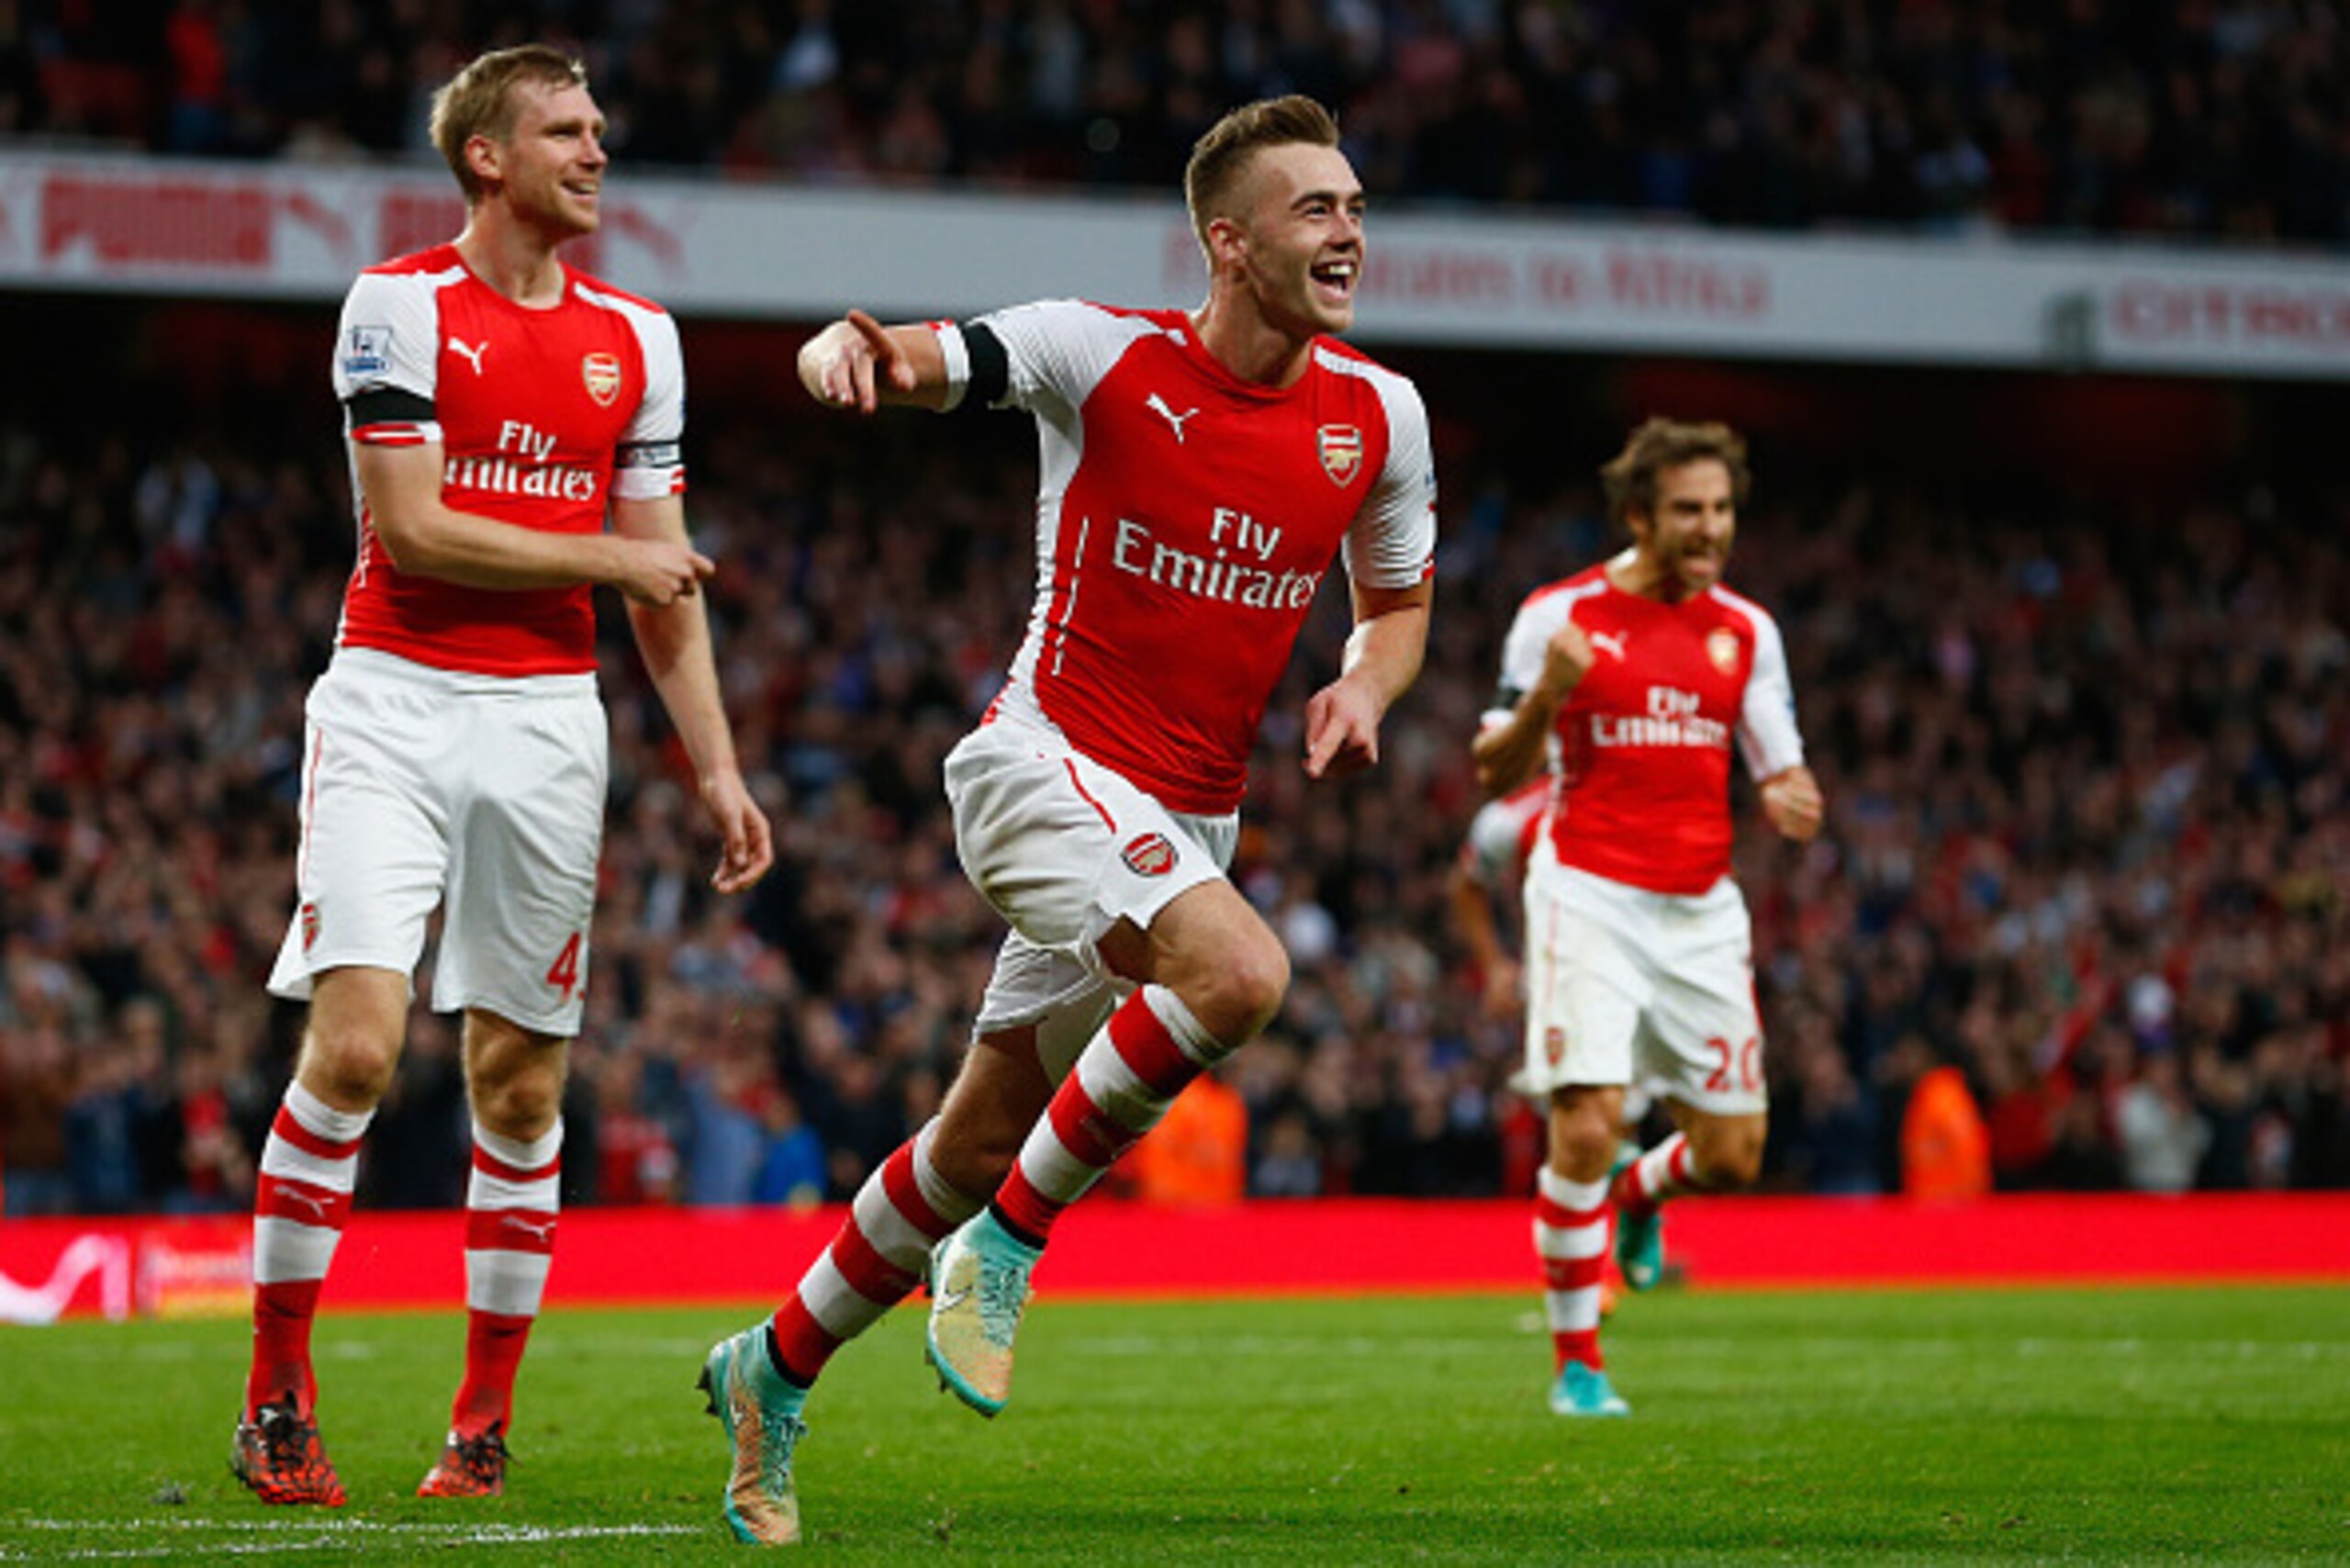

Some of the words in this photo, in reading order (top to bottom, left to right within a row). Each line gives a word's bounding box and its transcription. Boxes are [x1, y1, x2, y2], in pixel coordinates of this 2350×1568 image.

[498, 420, 556, 462] Fly
[443, 458, 596, 501] mirates
[1210, 507, 1281, 561] Fly
[1647, 686, 1700, 718] Fly
[545, 930, 581, 1006] 4
[1705, 1036, 1763, 1092] 20
